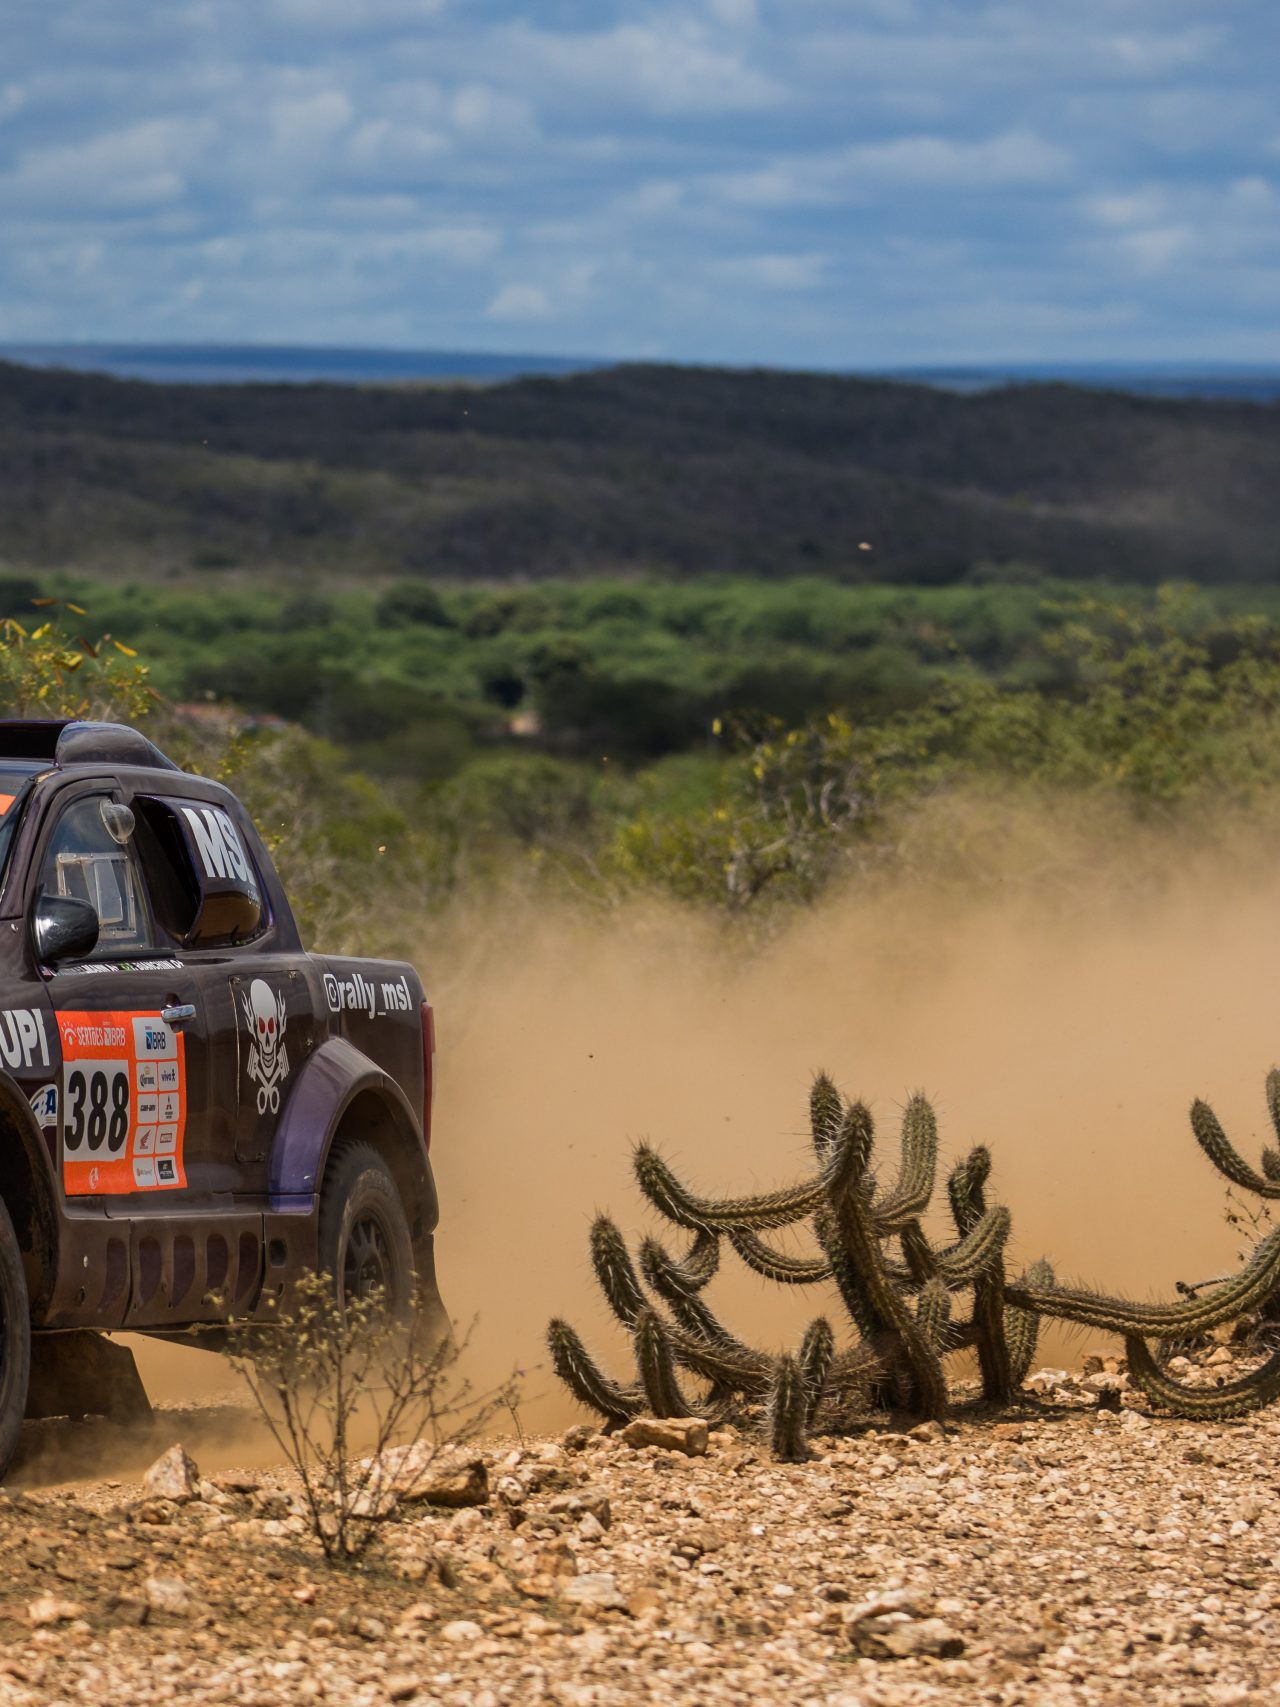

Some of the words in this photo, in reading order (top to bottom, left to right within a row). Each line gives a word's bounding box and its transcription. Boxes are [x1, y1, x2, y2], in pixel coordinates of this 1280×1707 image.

[111, 1027, 126, 1047] BRB
[153, 1031, 166, 1050] BRB
[64, 1070, 129, 1152] 388
